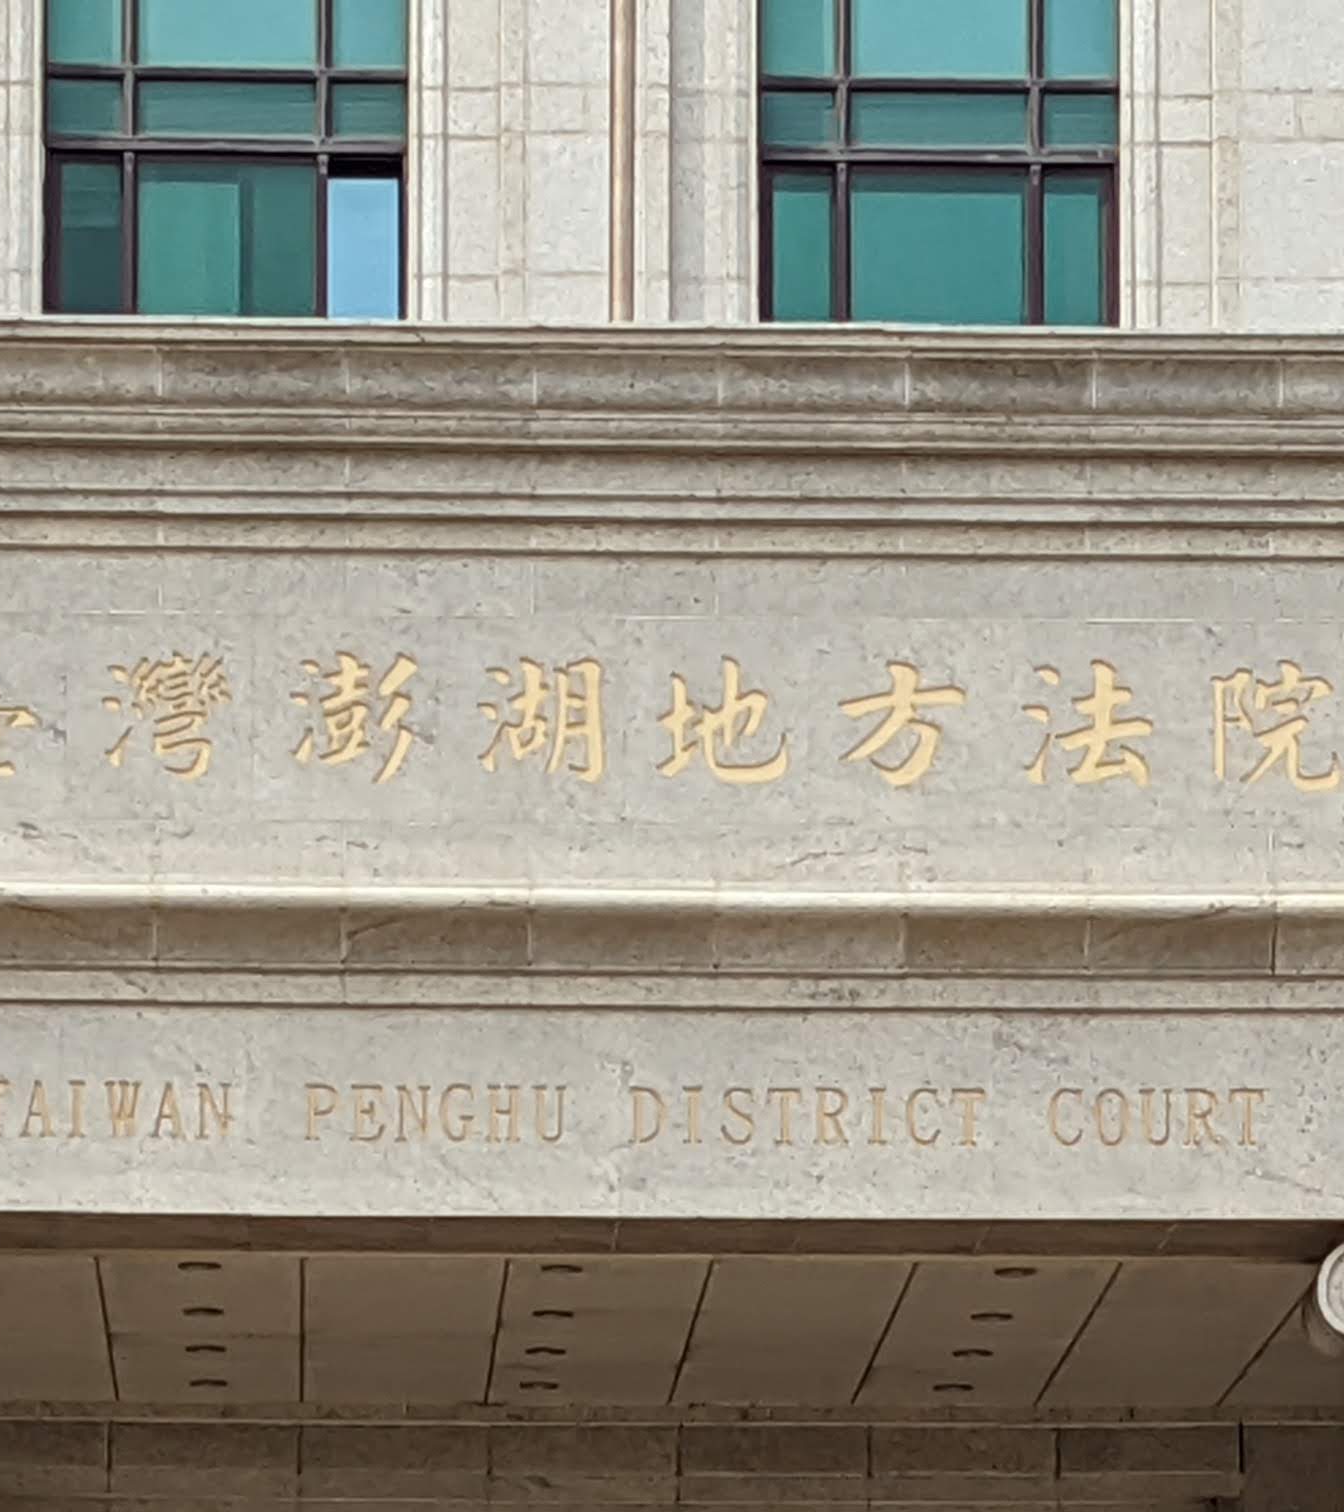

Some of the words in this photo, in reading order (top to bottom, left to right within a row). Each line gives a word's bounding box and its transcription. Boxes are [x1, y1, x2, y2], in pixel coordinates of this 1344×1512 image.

[303, 1081, 569, 1143] PENGHU
[626, 1085, 987, 1146] DISTRICT
[1047, 1086, 1269, 1147] COURT
